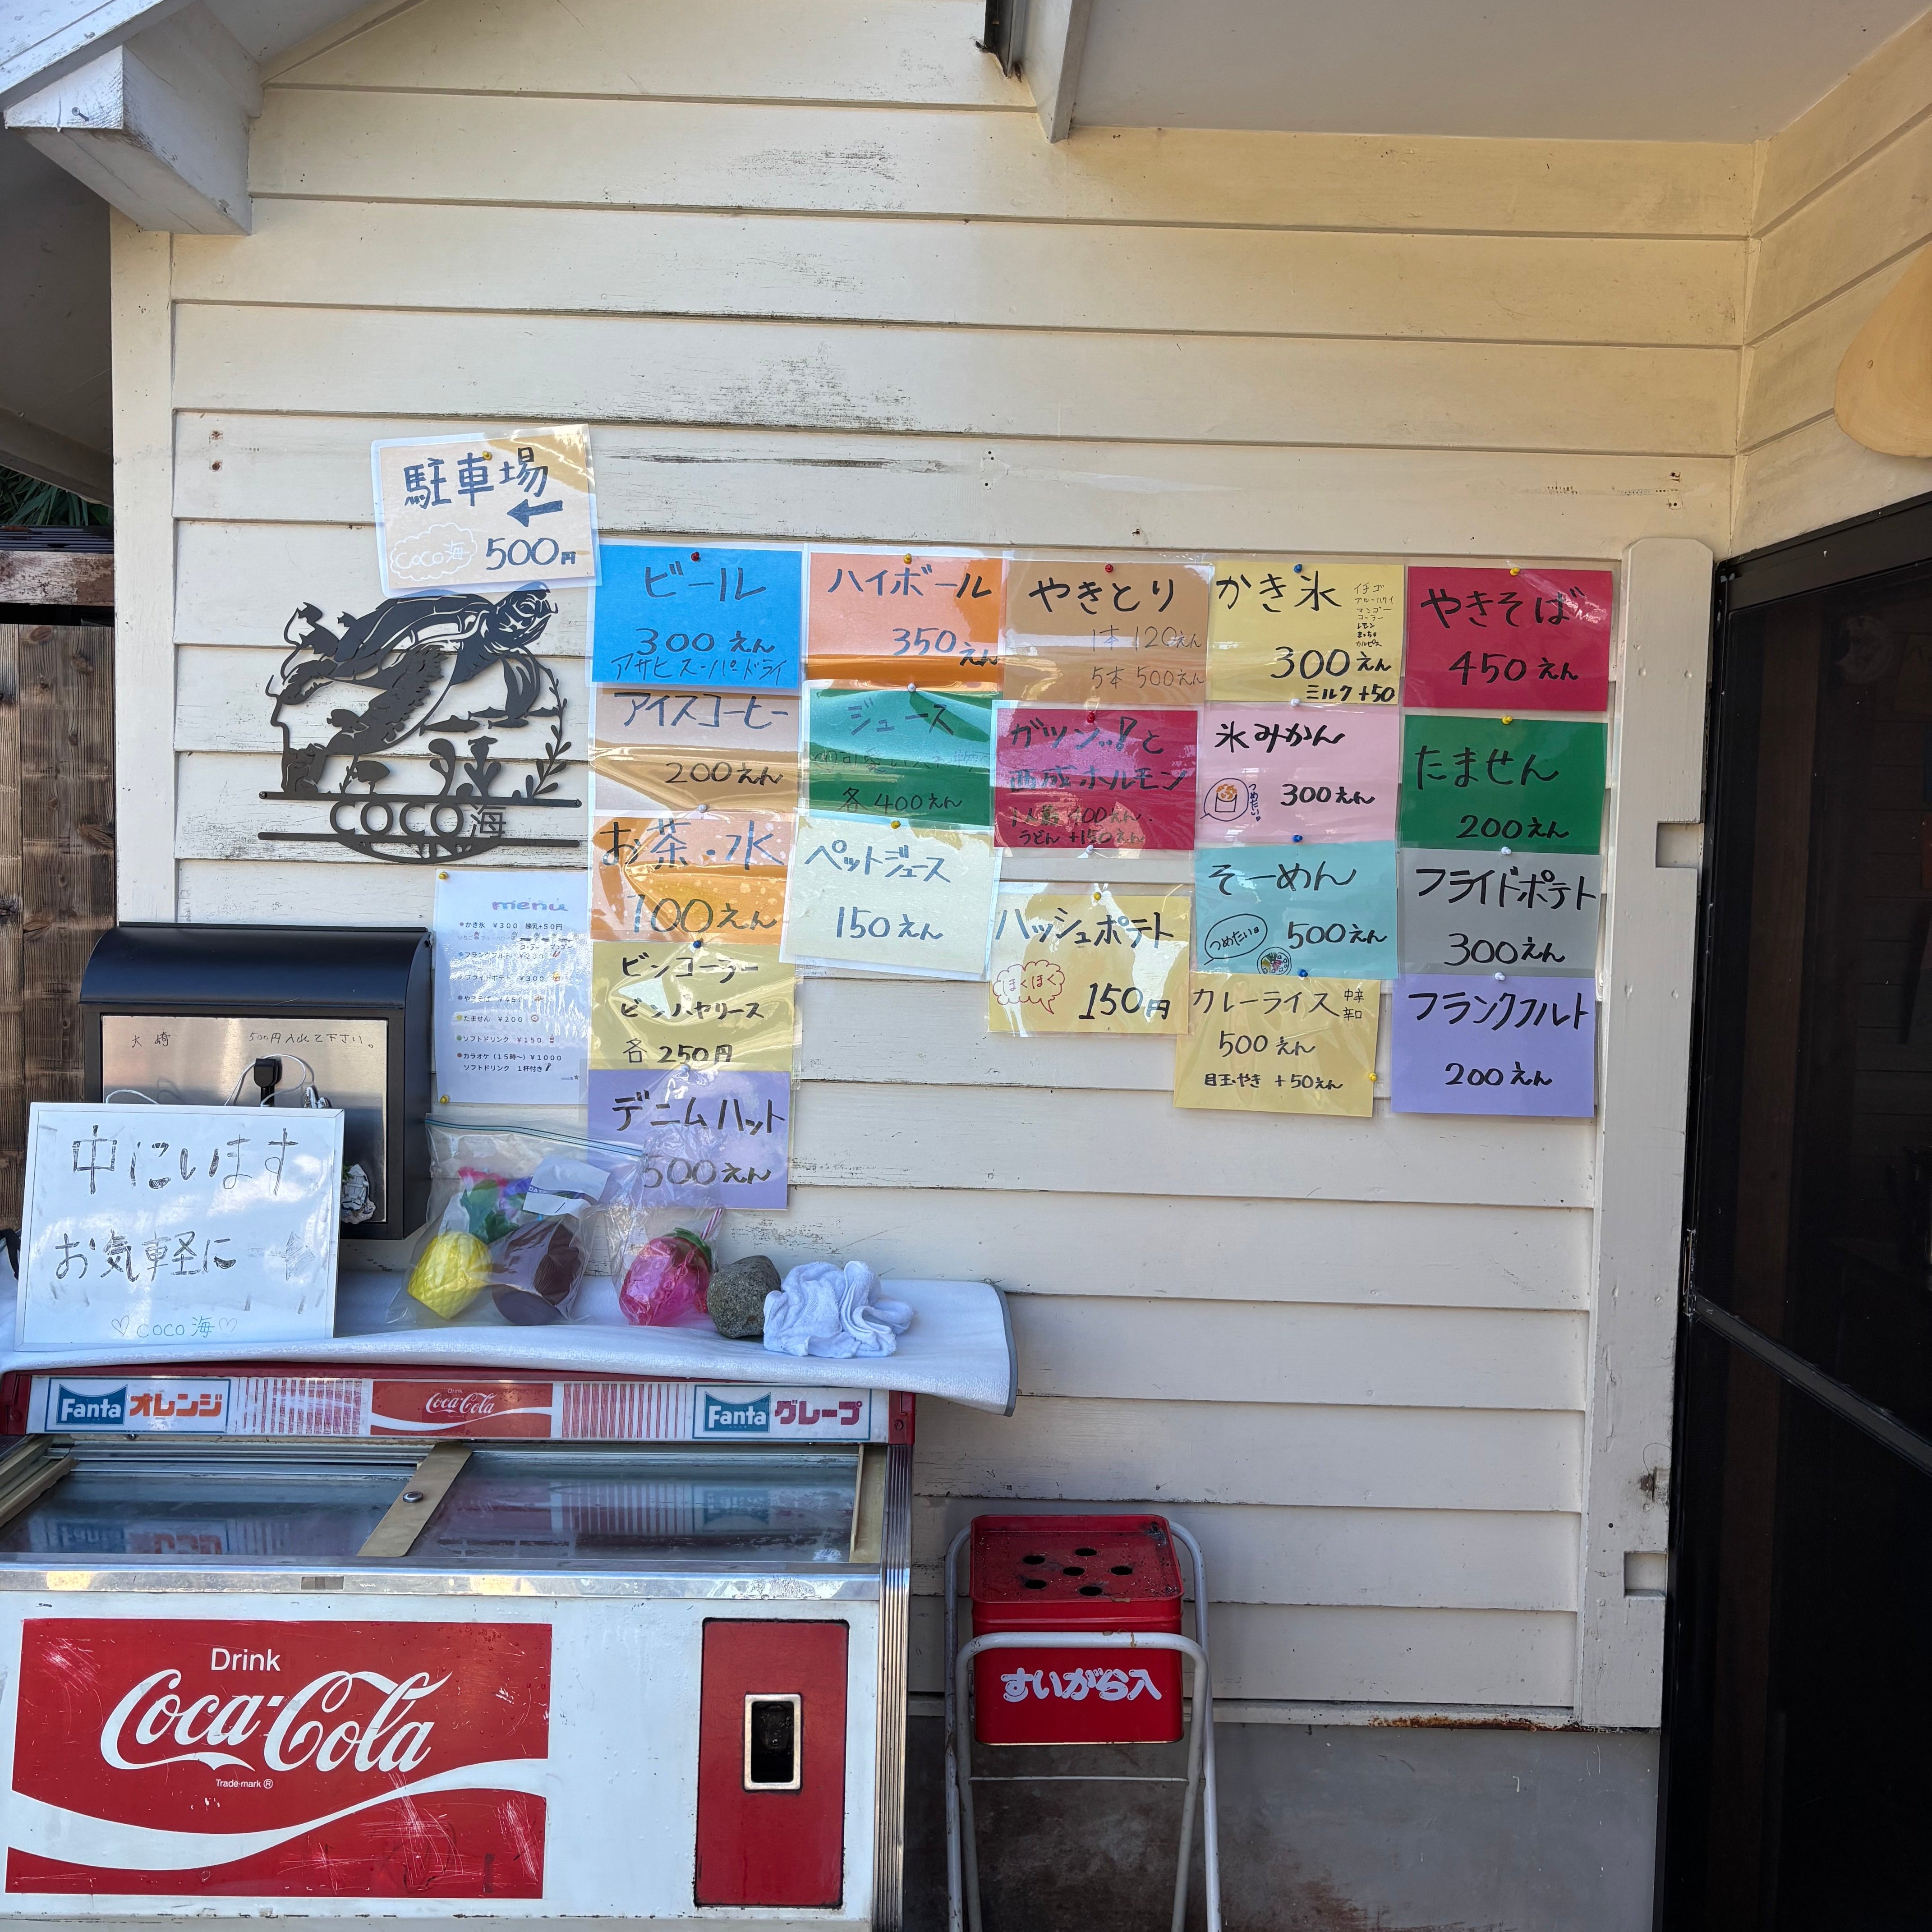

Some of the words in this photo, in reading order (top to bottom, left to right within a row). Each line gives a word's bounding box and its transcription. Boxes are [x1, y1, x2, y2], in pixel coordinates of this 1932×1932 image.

[404, 447, 548, 509] 駐車場
[485, 537, 577, 570] 500円
[645, 561, 767, 602] ビール
[828, 564, 993, 598] ハイボール
[1028, 577, 1173, 615] やきとり
[1216, 570, 1342, 613] かき氷
[1354, 582, 1384, 594] イチゴ
[1421, 586, 1588, 629] やきそば
[892, 627, 998, 667] 350えん
[1355, 639, 1382, 648] カルピス
[1136, 666, 1205, 689] 500えん
[1270, 646, 1392, 679] 300えん
[1449, 650, 1579, 685] 450えん
[614, 692, 789, 730] アイスコーヒー
[847, 697, 954, 736] ジュース
[1214, 721, 1345, 753] 氷みかん
[665, 762, 783, 786] 200えん
[1415, 745, 1559, 790] たません
[1280, 783, 1375, 806] 300えん
[1019, 830, 1060, 845] うどん
[1456, 814, 1569, 839] 200えん
[804, 839, 951, 883] ペットジュース
[1208, 860, 1357, 896] そーめん
[1416, 866, 1596, 911] フライドポテト
[492, 900, 569, 912] menu
[627, 893, 777, 933] 100えん
[836, 906, 944, 941] 150えん
[995, 907, 1174, 949] ハッシュポテト
[1288, 921, 1388, 949] 500えん
[1443, 933, 1566, 966] 300えん
[1003, 974, 1056, 996] ほくほく
[1078, 982, 1171, 1020] 150円
[1193, 988, 1340, 1017] カレーライス
[1408, 992, 1590, 1031] フランクフルト
[1219, 1030, 1316, 1058] 500えん
[1204, 1072, 1261, 1089] 目玉やき
[1444, 1061, 1553, 1086] 200えん
[612, 1090, 786, 1136] デニムハット
[72, 1125, 299, 1196] 中にいます
[55, 1230, 237, 1283] お気軽に
[61, 1398, 121, 1421] Fanta
[129, 1393, 223, 1417] オレンジ
[425, 1392, 498, 1414] Coca-Cola
[708, 1405, 767, 1428] Fanta
[774, 1399, 863, 1425] グレープ
[211, 1647, 281, 1672] Drink
[1000, 1667, 1163, 1703] すいがら入
[100, 1669, 453, 1772] Coca-Cola
